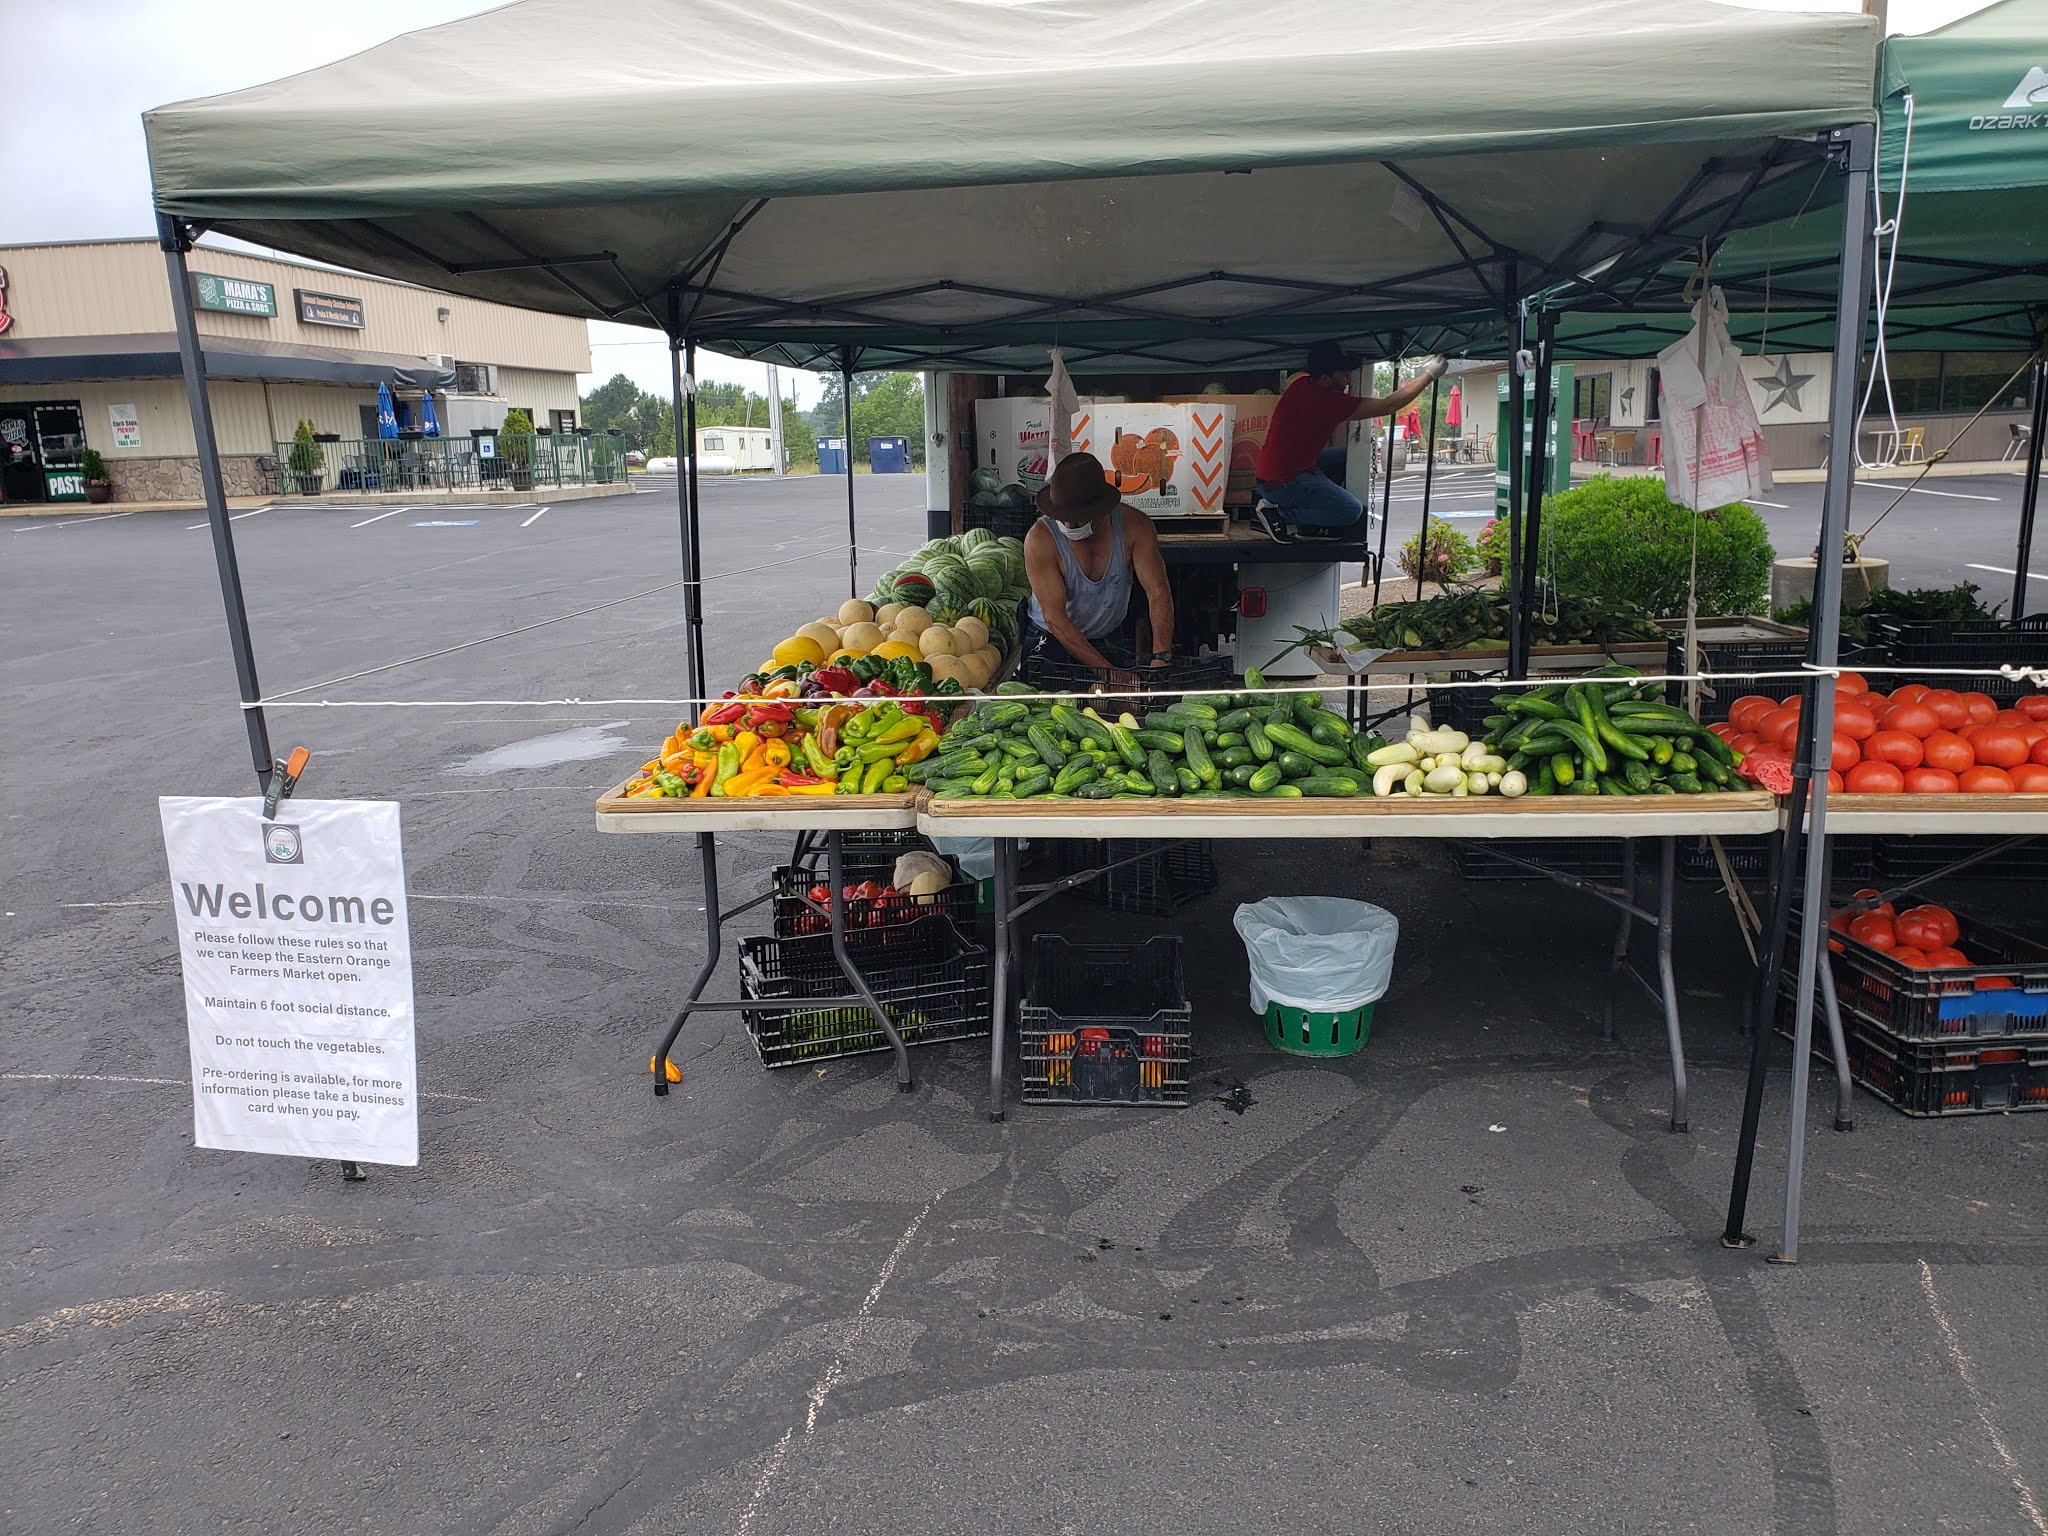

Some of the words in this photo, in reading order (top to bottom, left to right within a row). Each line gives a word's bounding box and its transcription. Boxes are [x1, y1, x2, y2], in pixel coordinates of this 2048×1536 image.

[223, 280, 268, 302] MAMA'S
[226, 299, 245, 310] PIZZA
[245, 302, 251, 311] &
[251, 302, 270, 313] SUBS
[1025, 420, 1042, 430] Fresh
[181, 882, 395, 925] Welcome
[195, 931, 235, 944] Please
[238, 933, 275, 946] follow
[278, 935, 311, 948] these
[315, 937, 345, 949] rules
[347, 941, 362, 950] so
[364, 939, 389, 951] that
[196, 949, 215, 959] we
[218, 950, 240, 960] can
[242, 949, 272, 964] keep
[275, 950, 295, 963] the
[298, 952, 344, 965] Eastern
[346, 955, 391, 970] Orange
[230, 964, 280, 978] Farmers
[283, 967, 325, 981] Market
[328, 972, 362, 984] open.
[206, 996, 257, 1010] Maintain
[261, 999, 268, 1011] 6
[270, 999, 295, 1013] foot
[298, 1002, 333, 1015] social
[336, 1003, 391, 1018] distance.
[216, 1035, 233, 1046] Do
[236, 1037, 255, 1047] not
[258, 1037, 291, 1049] touch
[294, 1038, 314, 1051] the
[317, 1041, 385, 1055] vegetables.
[203, 1067, 278, 1085] Pre-ordering
[281, 1070, 291, 1083] is
[294, 1072, 350, 1088] available,
[352, 1075, 369, 1087] for
[372, 1079, 403, 1090] more
[202, 1082, 269, 1097] information
[273, 1086, 311, 1100] please
[314, 1089, 339, 1102] take
[342, 1093, 349, 1102] a
[353, 1091, 405, 1107] business
[248, 1102, 275, 1113] card
[278, 1103, 309, 1116] when
[312, 1107, 334, 1119] you
[337, 1109, 361, 1122] pay.
